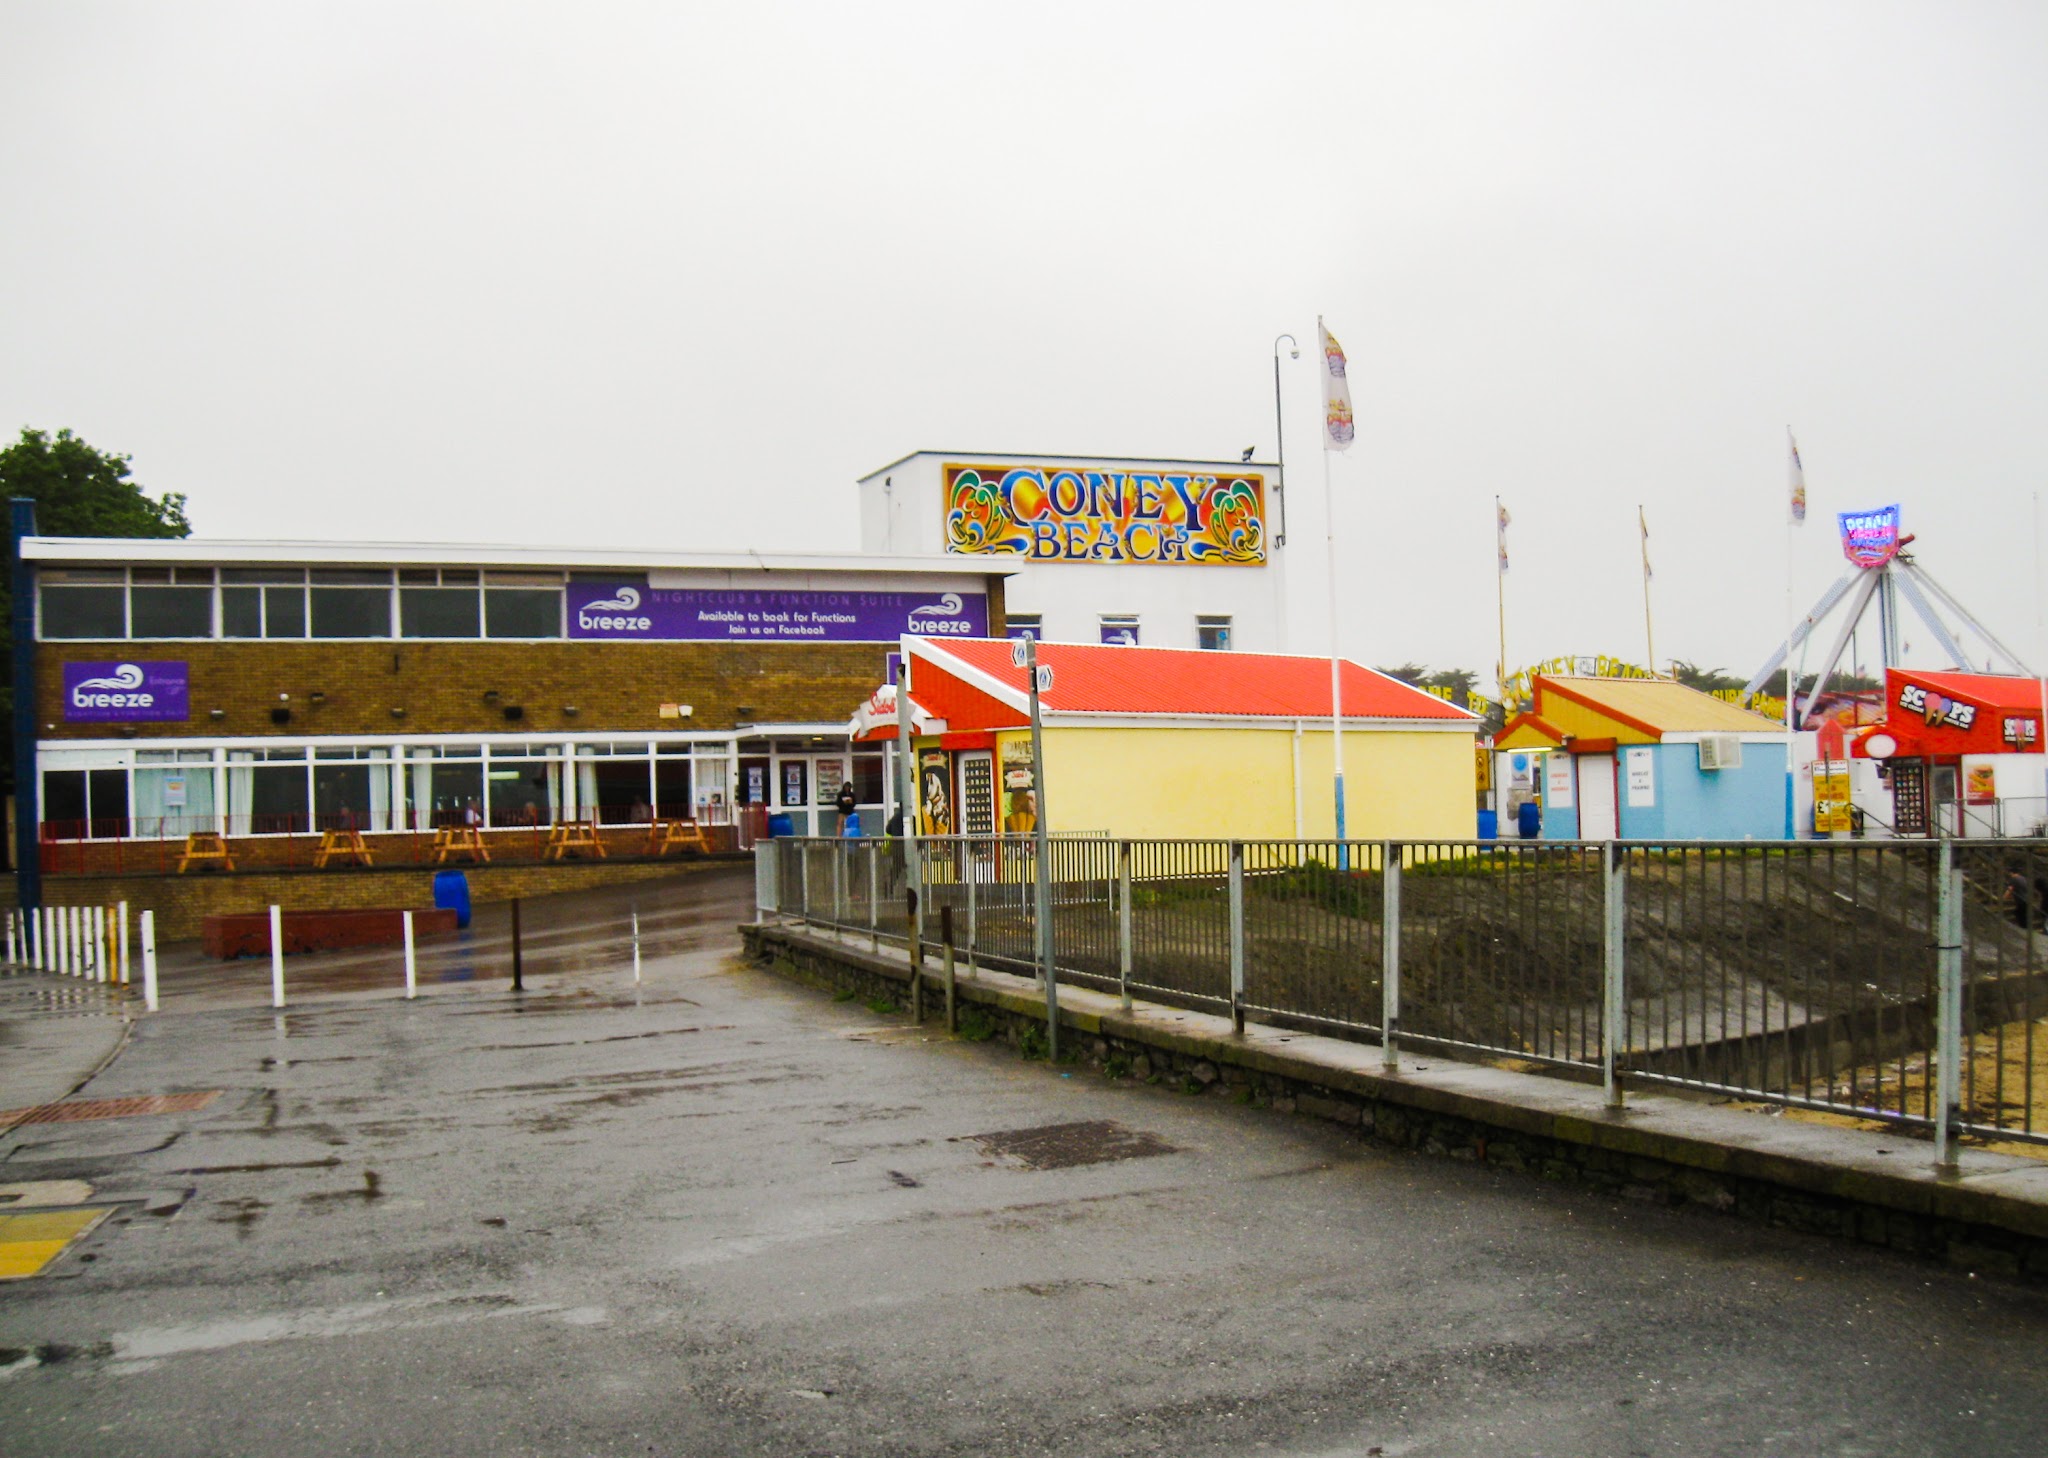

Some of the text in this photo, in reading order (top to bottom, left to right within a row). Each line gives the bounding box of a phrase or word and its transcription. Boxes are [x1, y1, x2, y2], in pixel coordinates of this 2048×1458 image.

[998, 468, 1217, 532] CONEY
[1028, 521, 1189, 561] BEACH
[651, 592, 746, 603] NIGHTCLUB
[770, 594, 850, 606] FUNCTION
[860, 595, 903, 607] SUITE
[578, 610, 652, 631] breeze
[698, 611, 856, 624] Available to book for Functions
[907, 614, 972, 633] breeze
[728, 624, 825, 635] Join us on Facebook
[73, 686, 154, 708] breeze
